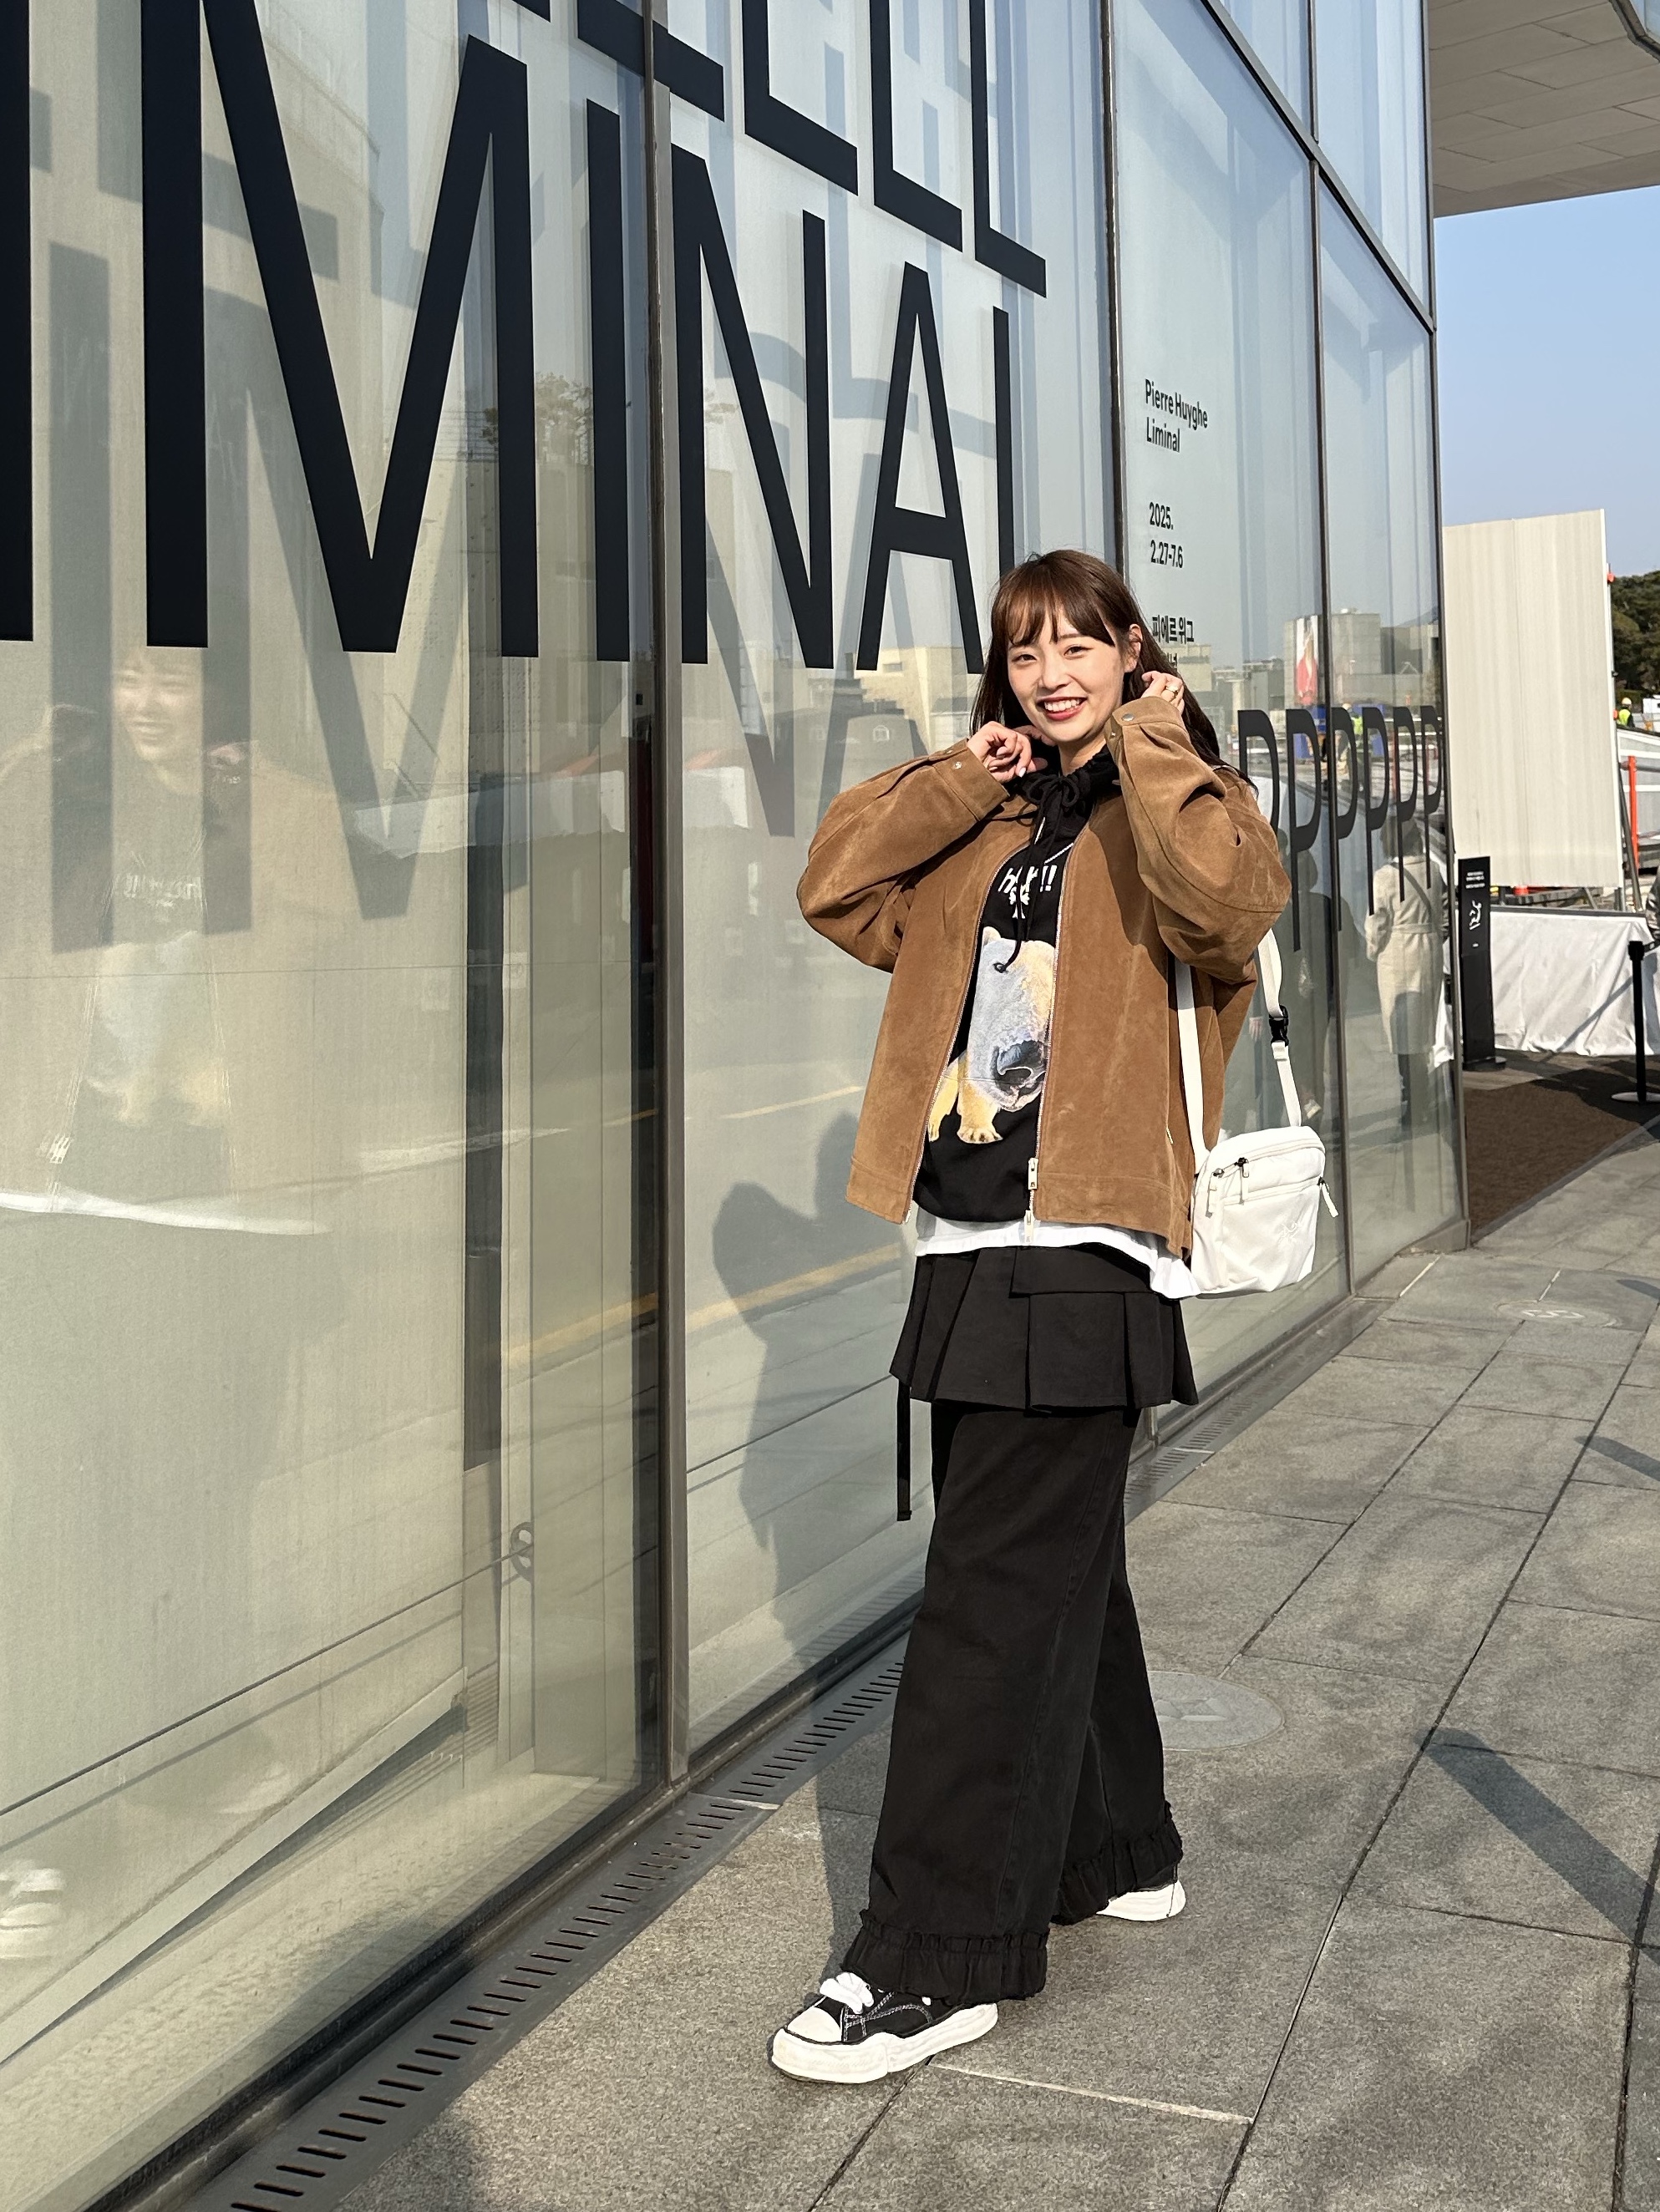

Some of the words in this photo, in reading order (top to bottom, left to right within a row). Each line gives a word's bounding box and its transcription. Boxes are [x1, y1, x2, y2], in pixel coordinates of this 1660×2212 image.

[1145, 378, 1174, 414] Pierre
[1175, 392, 1208, 431] Huyghe
[1146, 417, 1180, 453] Liminal
[1149, 501, 1174, 530] 2025.
[1150, 539, 1184, 569] 2.27-7.6
[1152, 614, 1178, 643] 피에르
[1179, 616, 1195, 645] 위그
